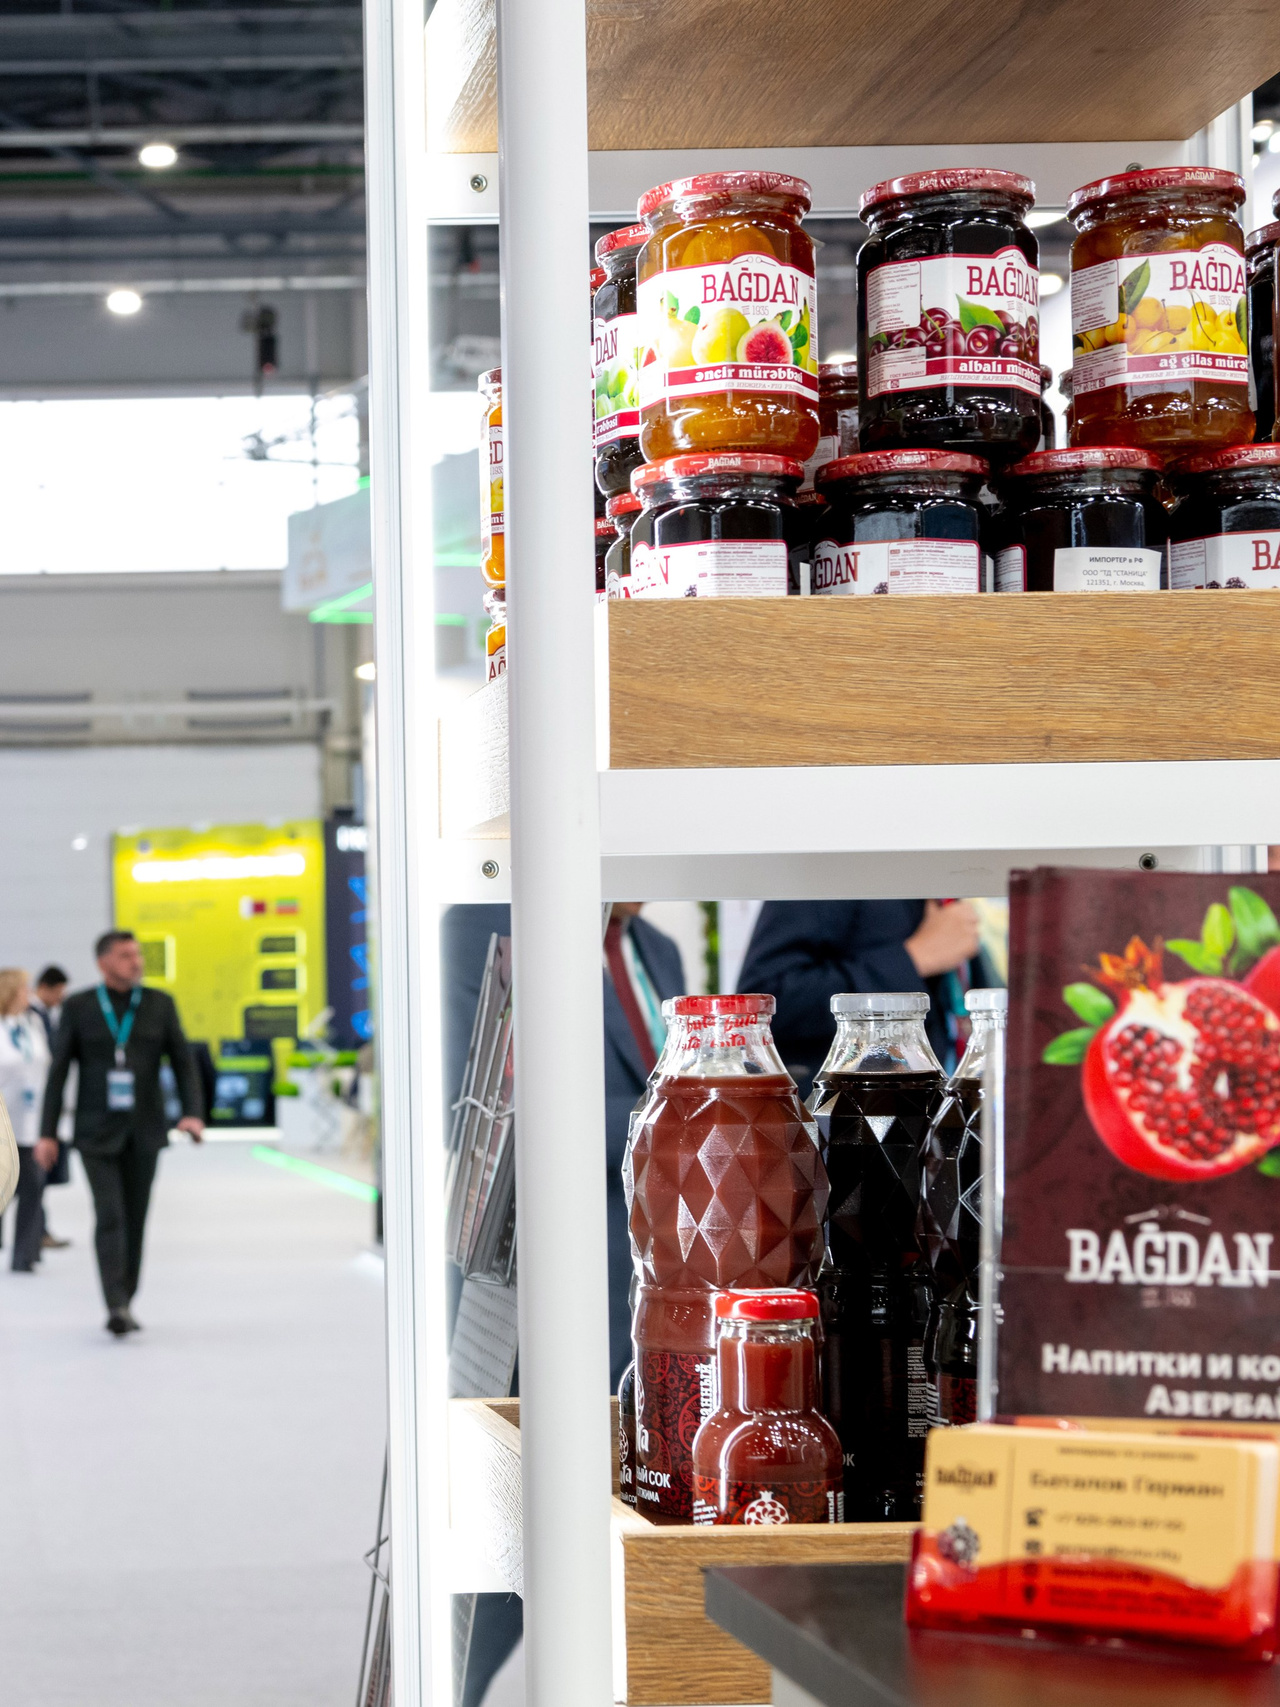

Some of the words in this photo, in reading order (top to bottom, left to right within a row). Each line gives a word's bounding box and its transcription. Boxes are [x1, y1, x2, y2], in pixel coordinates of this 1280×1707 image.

[701, 267, 798, 306] BAĞDAN
[966, 262, 1038, 307] BAĞDAN
[1170, 256, 1246, 294] BAĞDA
[595, 327, 618, 366] DAN
[1159, 355, 1177, 369] ağ
[1182, 354, 1212, 368] gilas
[694, 366, 735, 382] əncir
[814, 551, 861, 590] ĞDAN
[1251, 540, 1280, 571] BA
[1065, 1222, 1274, 1288] BAĞDAN
[649, 1470, 671, 1488] СОК
